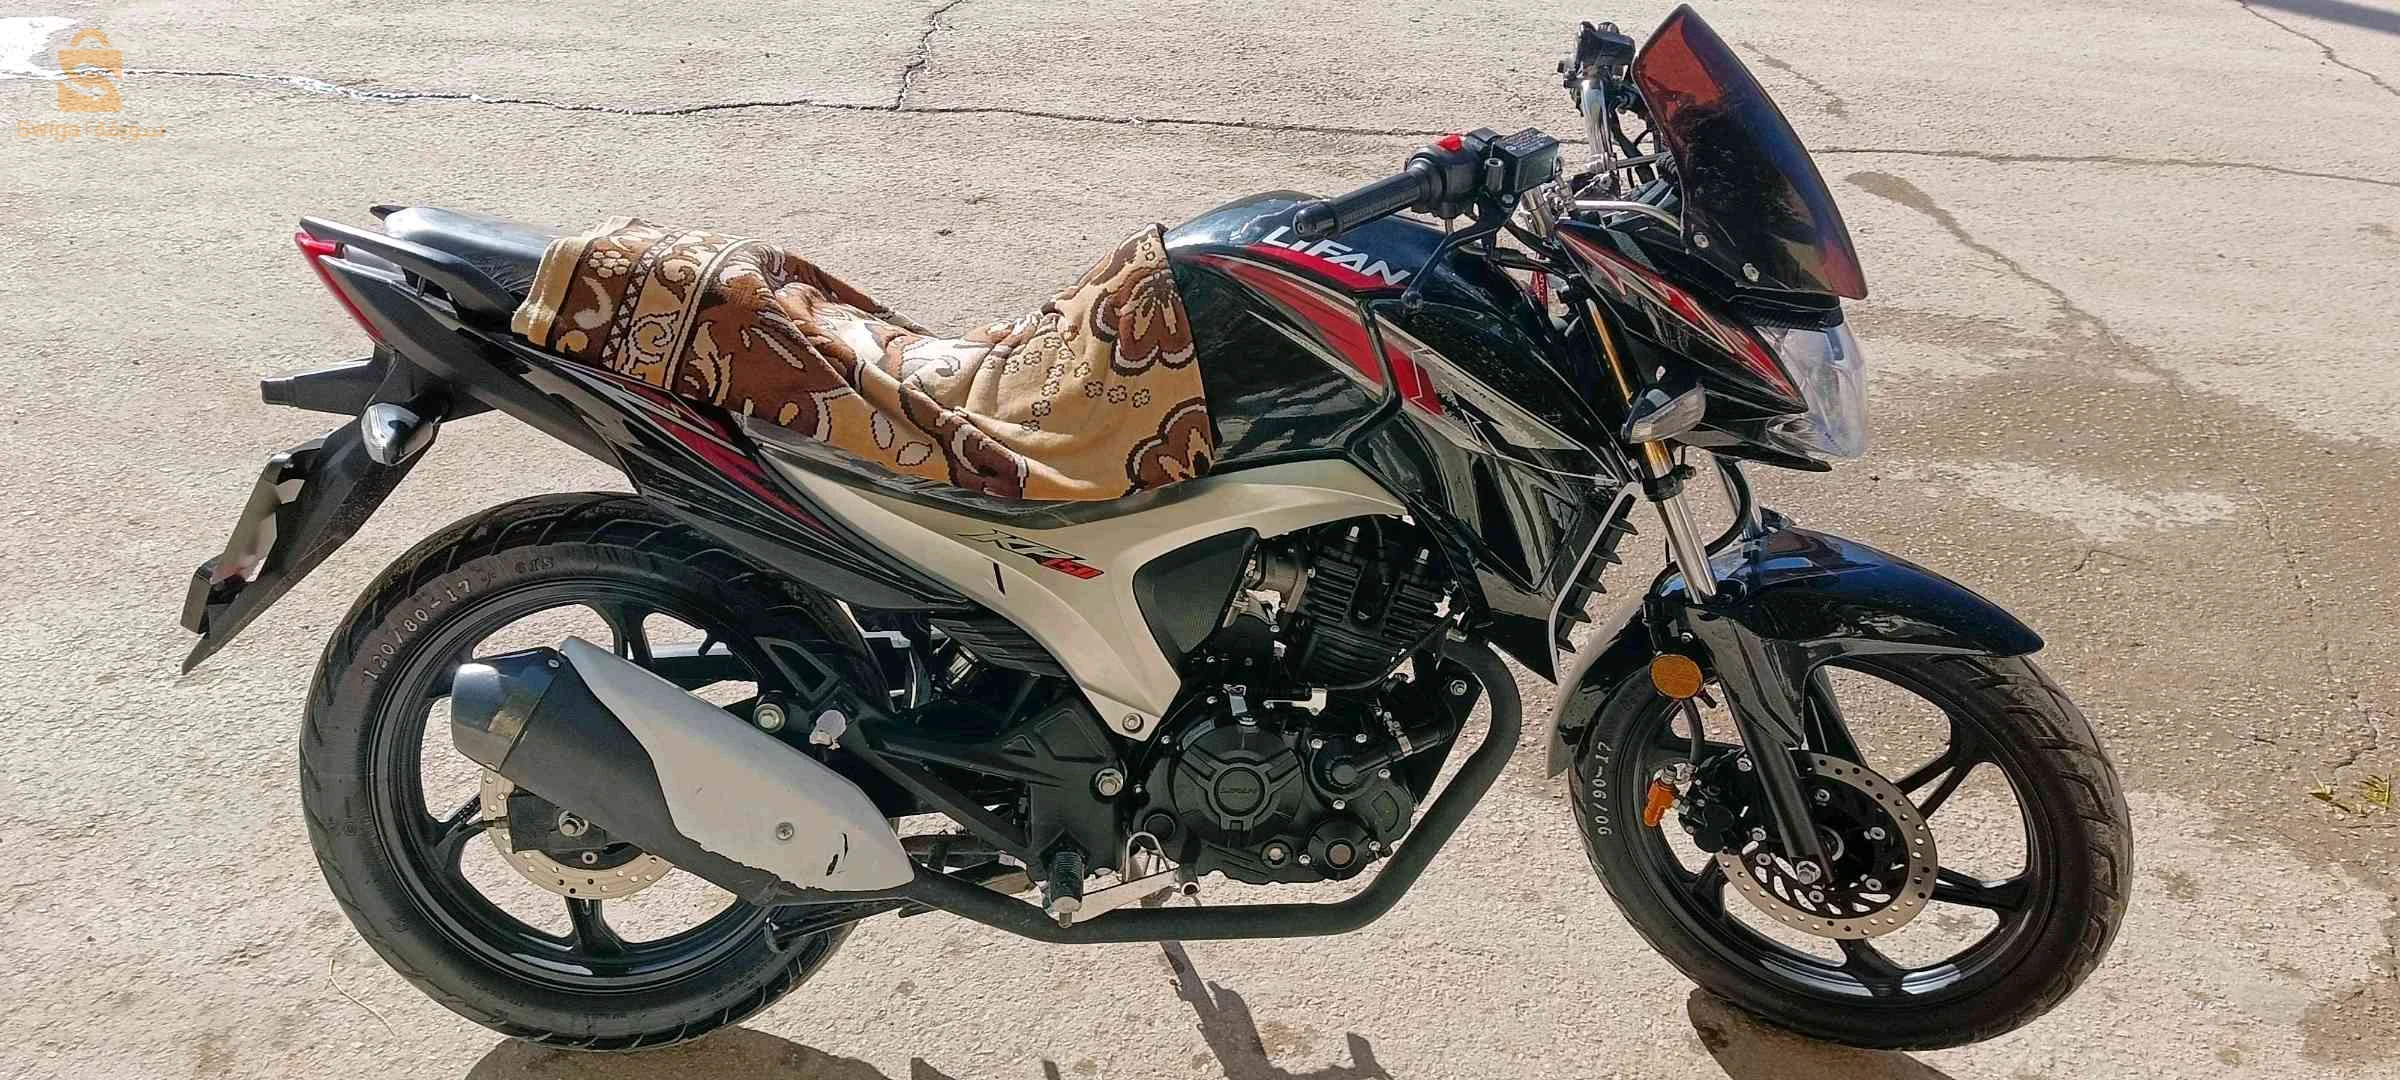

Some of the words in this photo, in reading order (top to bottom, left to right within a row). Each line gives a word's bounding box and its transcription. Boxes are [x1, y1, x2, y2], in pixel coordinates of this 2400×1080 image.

[1262, 226, 1410, 286] LIFAN
[363, 578, 473, 681] 120/80-17
[1592, 741, 1612, 835] 90/90-17
